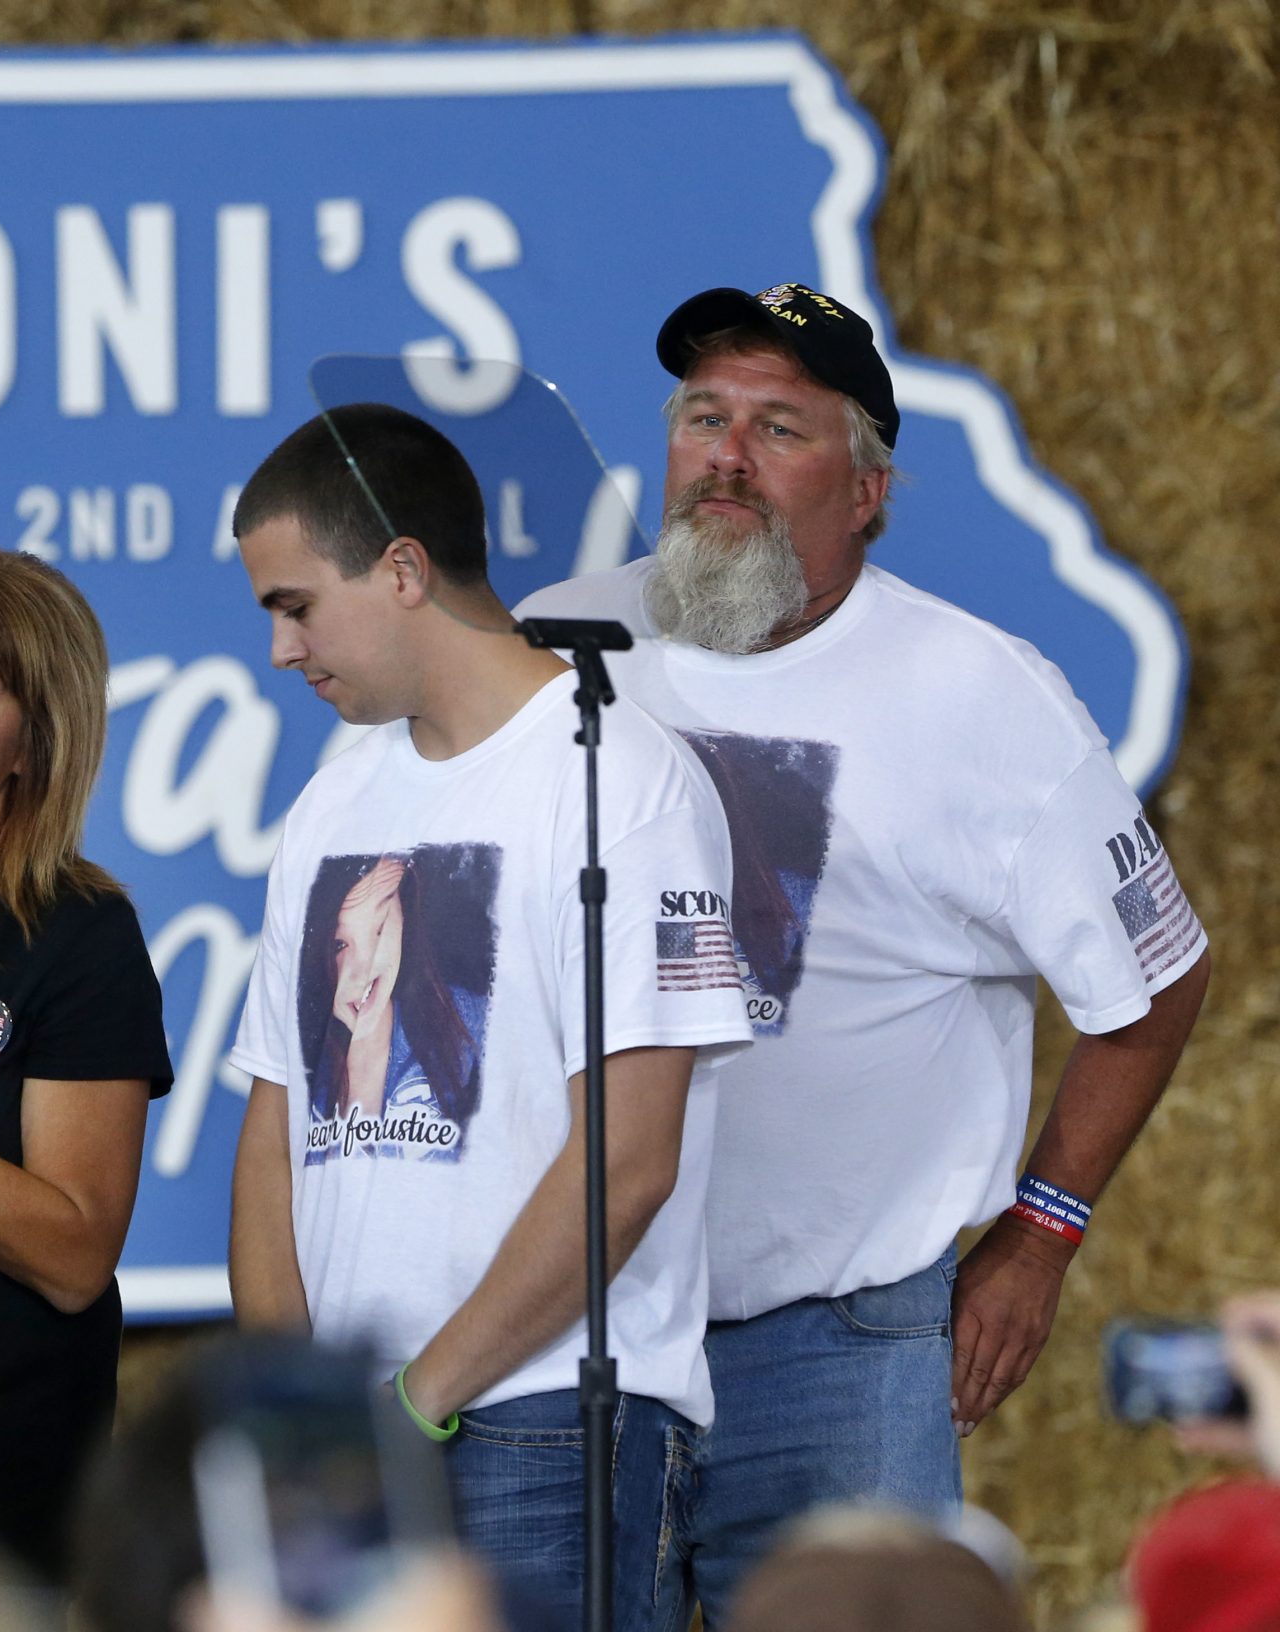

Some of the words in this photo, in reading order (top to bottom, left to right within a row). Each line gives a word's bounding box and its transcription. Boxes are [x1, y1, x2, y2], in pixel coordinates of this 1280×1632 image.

[16, 484, 173, 562] 2ND
[1105, 810, 1162, 884] DA
[344, 1106, 382, 1157] for
[382, 1110, 457, 1146] ustice
[1045, 1203, 1067, 1218] ROOT
[1057, 1193, 1079, 1208] ROOT
